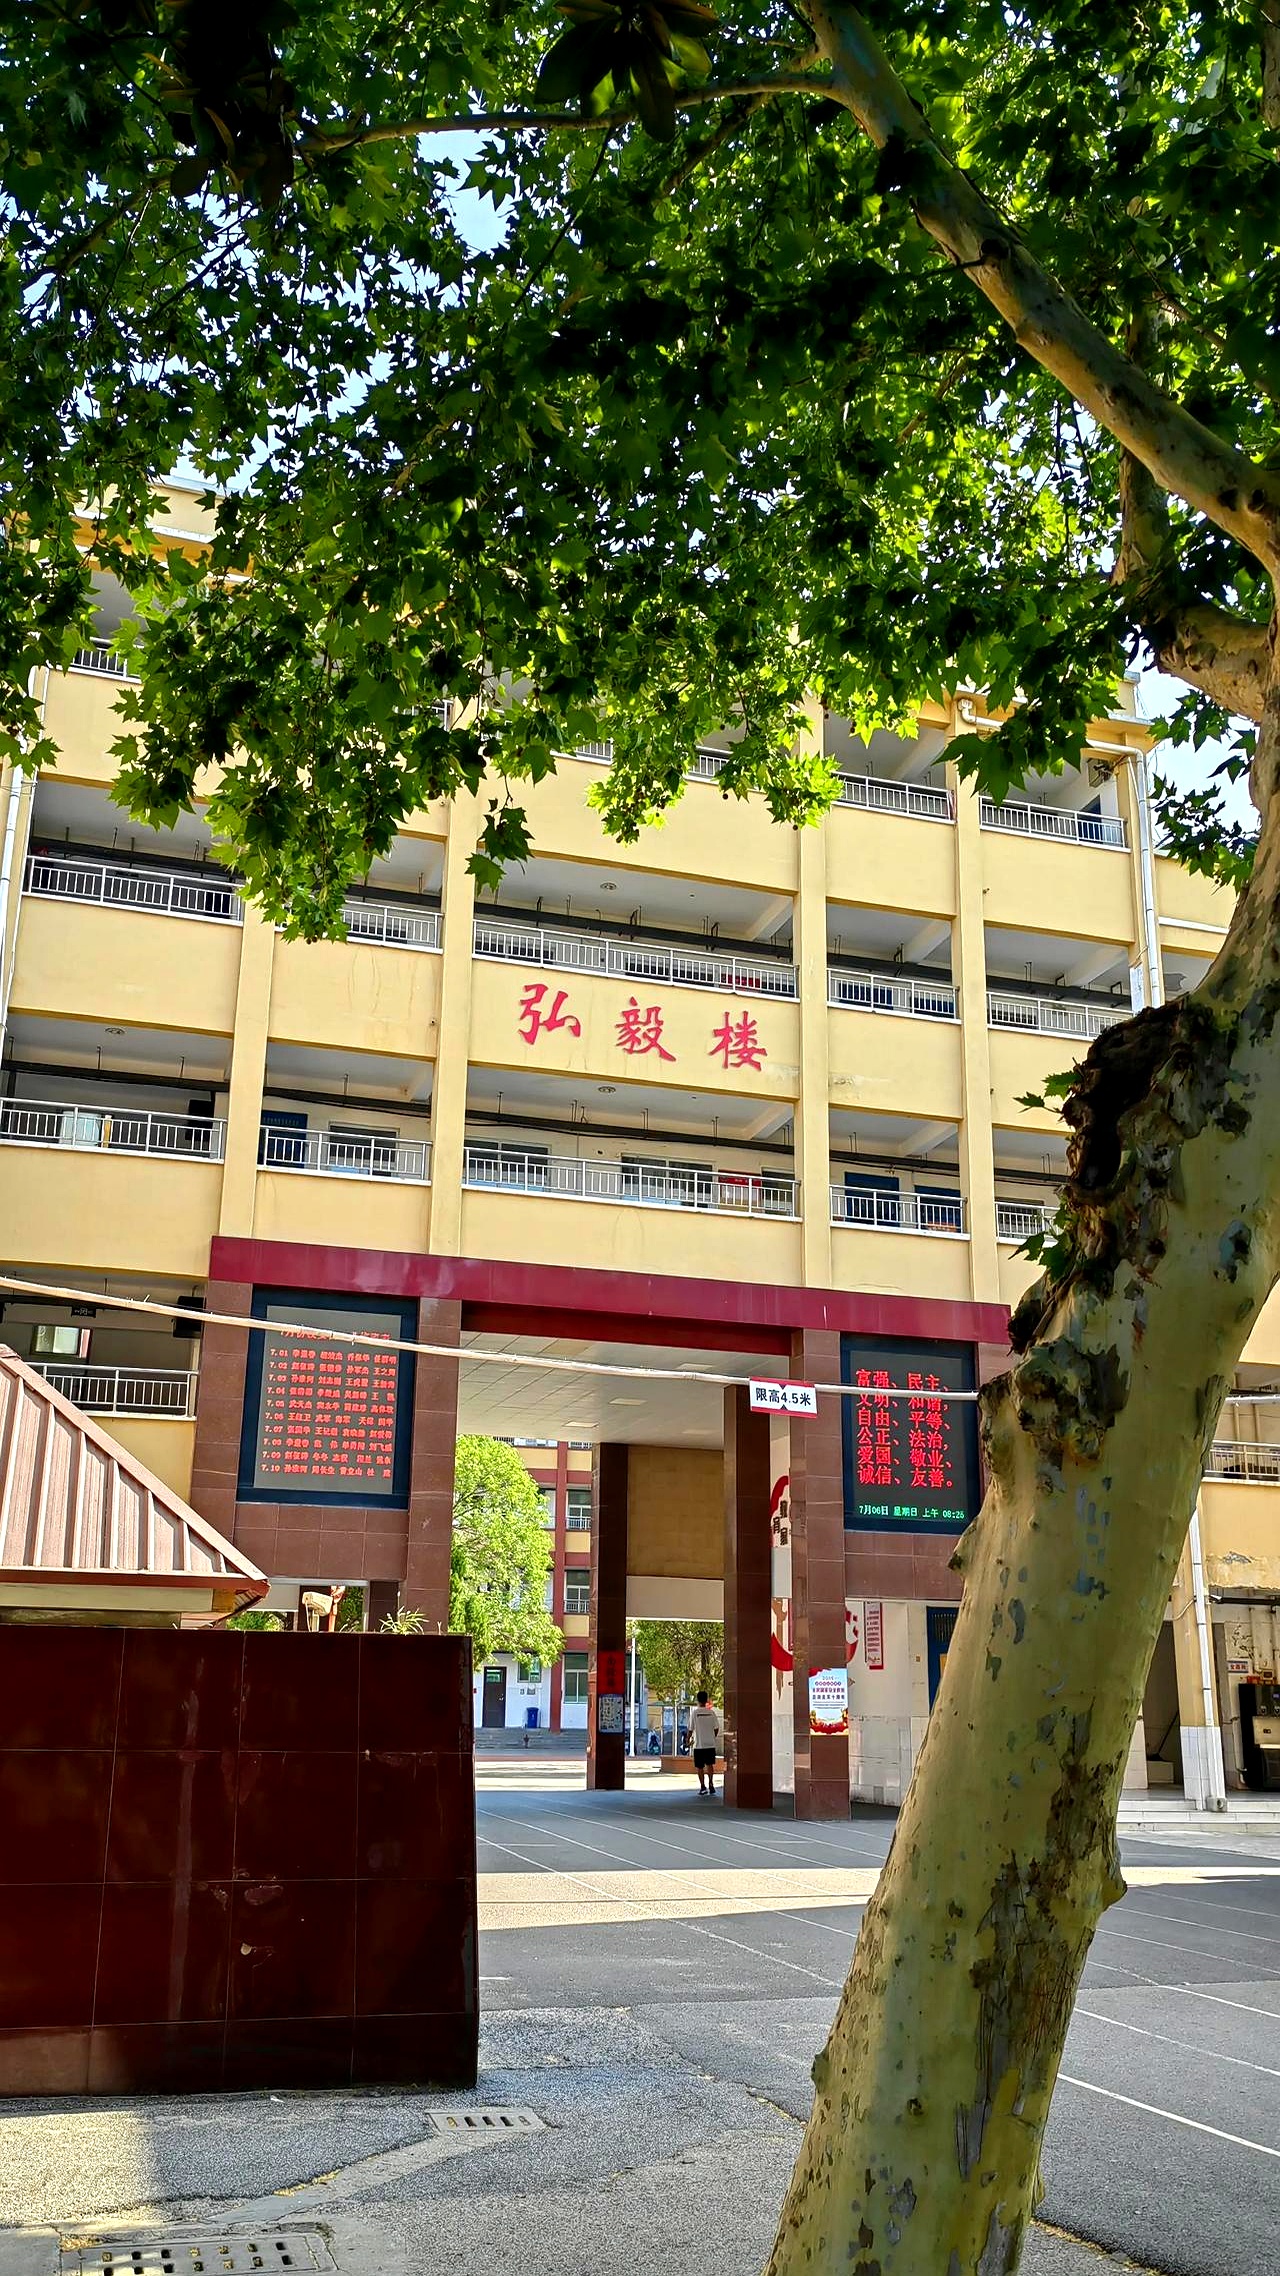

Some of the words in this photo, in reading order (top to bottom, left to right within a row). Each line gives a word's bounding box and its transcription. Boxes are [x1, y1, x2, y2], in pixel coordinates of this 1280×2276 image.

[517, 983, 768, 1072] 弘毅楼
[755, 1387, 811, 1406] 限高4.5米
[859, 1504, 889, 1516] 7月06日
[893, 1505, 918, 1517] 星期日
[922, 1507, 939, 1518] 上午
